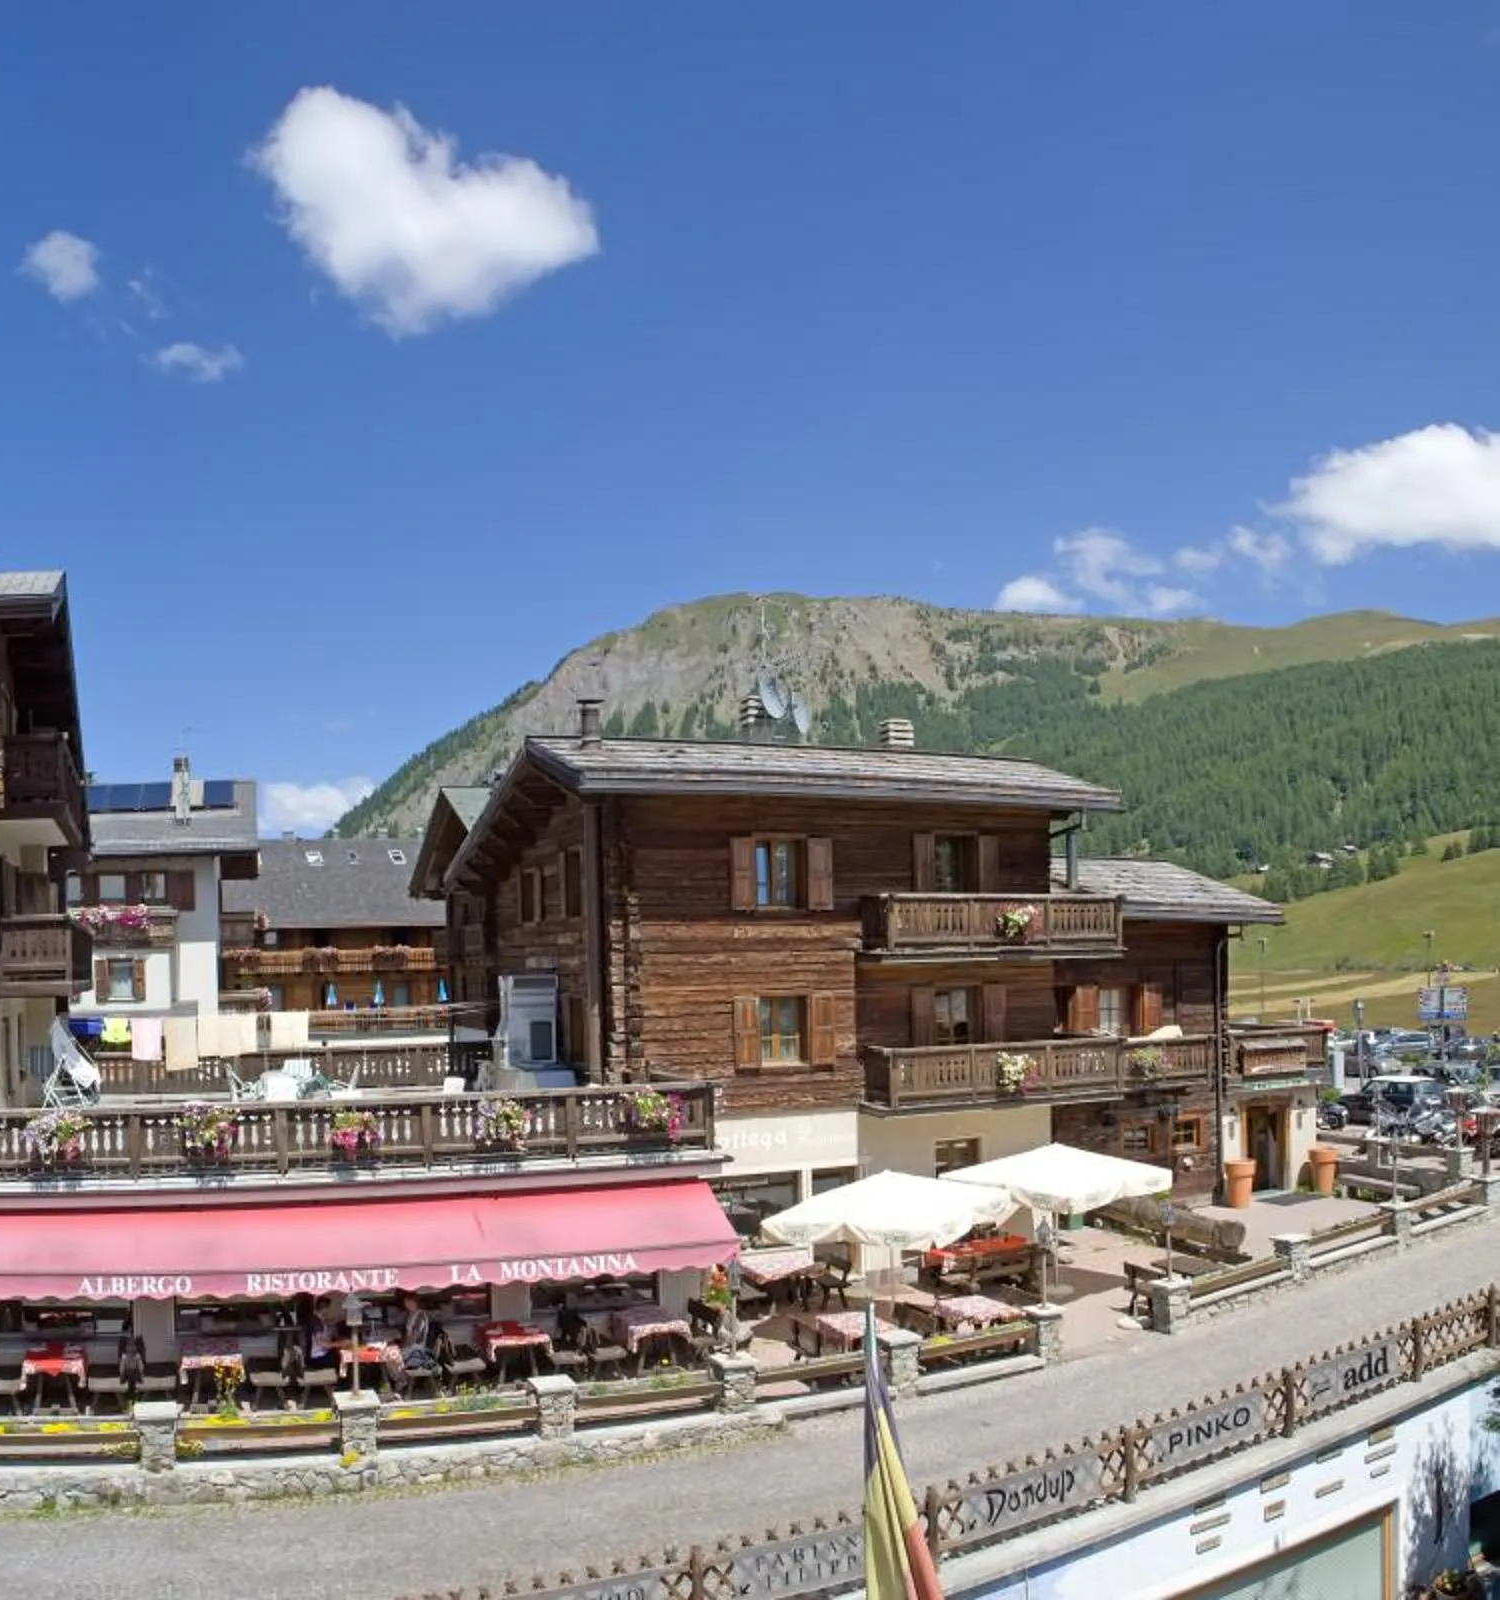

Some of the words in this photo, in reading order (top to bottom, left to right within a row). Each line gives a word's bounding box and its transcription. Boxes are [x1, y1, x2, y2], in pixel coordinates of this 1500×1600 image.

[716, 1125, 788, 1151] ottega
[78, 1275, 193, 1296] ALBERGO
[246, 1268, 400, 1293] RISTORANTE
[450, 1264, 482, 1283] LA
[499, 1252, 640, 1281] MONTANINA
[1343, 1346, 1389, 1390] add
[1168, 1407, 1251, 1454] PINKO
[984, 1469, 1076, 1526] Dondup
[756, 1536, 860, 1573] FABIAN
